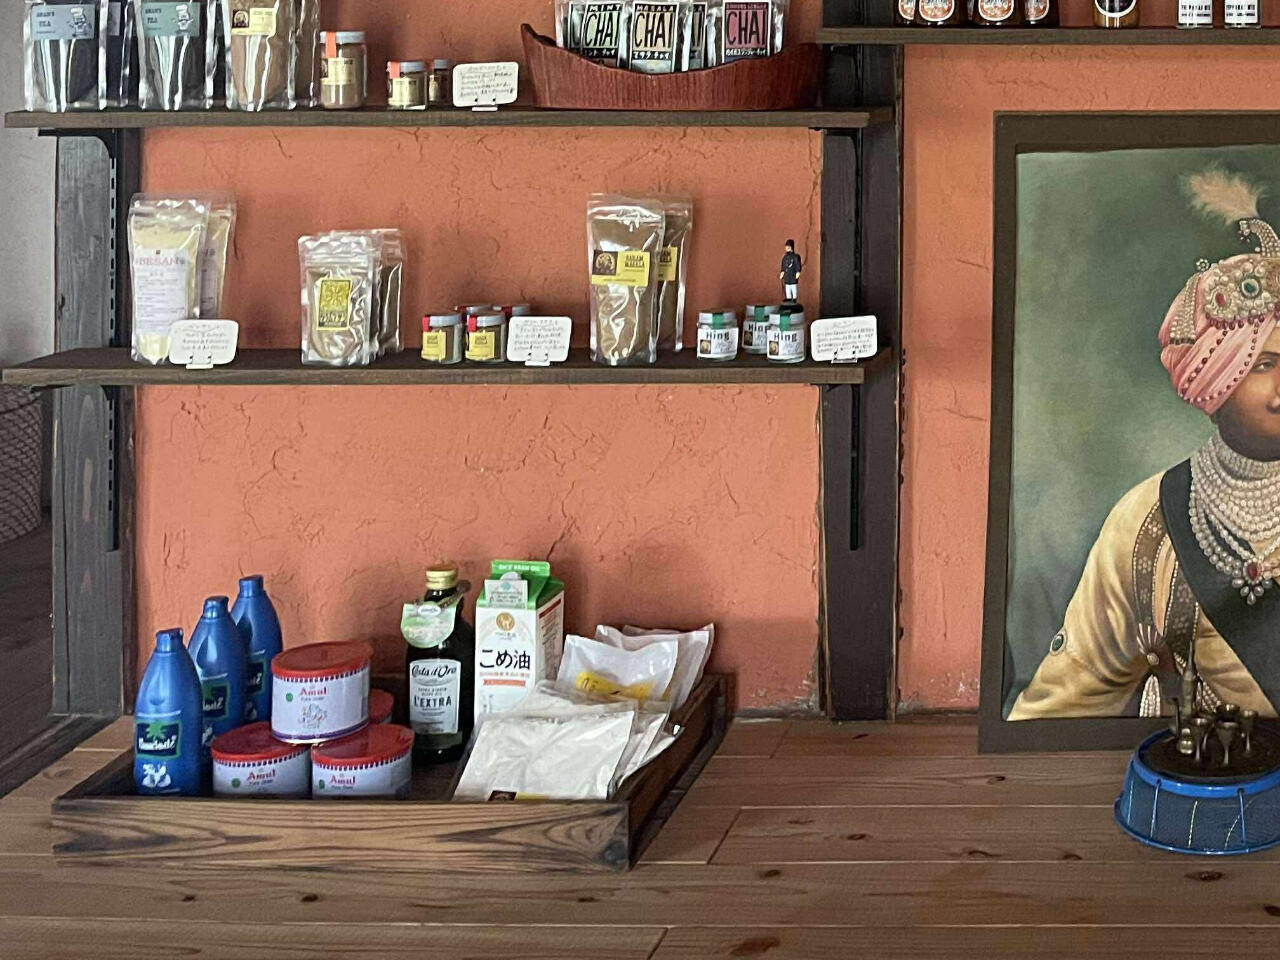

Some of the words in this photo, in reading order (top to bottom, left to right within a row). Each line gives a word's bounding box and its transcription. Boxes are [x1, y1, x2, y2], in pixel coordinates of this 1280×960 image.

[636, 4, 675, 12] MASALA
[584, 12, 619, 47] CHAI
[634, 13, 674, 47] CHAI
[725, 11, 766, 44] CHAI
[706, 331, 730, 340] Hing
[774, 332, 798, 341] Hing
[479, 648, 531, 670] こめ油
[300, 686, 326, 695] Amul
[414, 695, 452, 708] L'EXTRA
[246, 769, 276, 781] Amul
[329, 775, 356, 786] Amul
